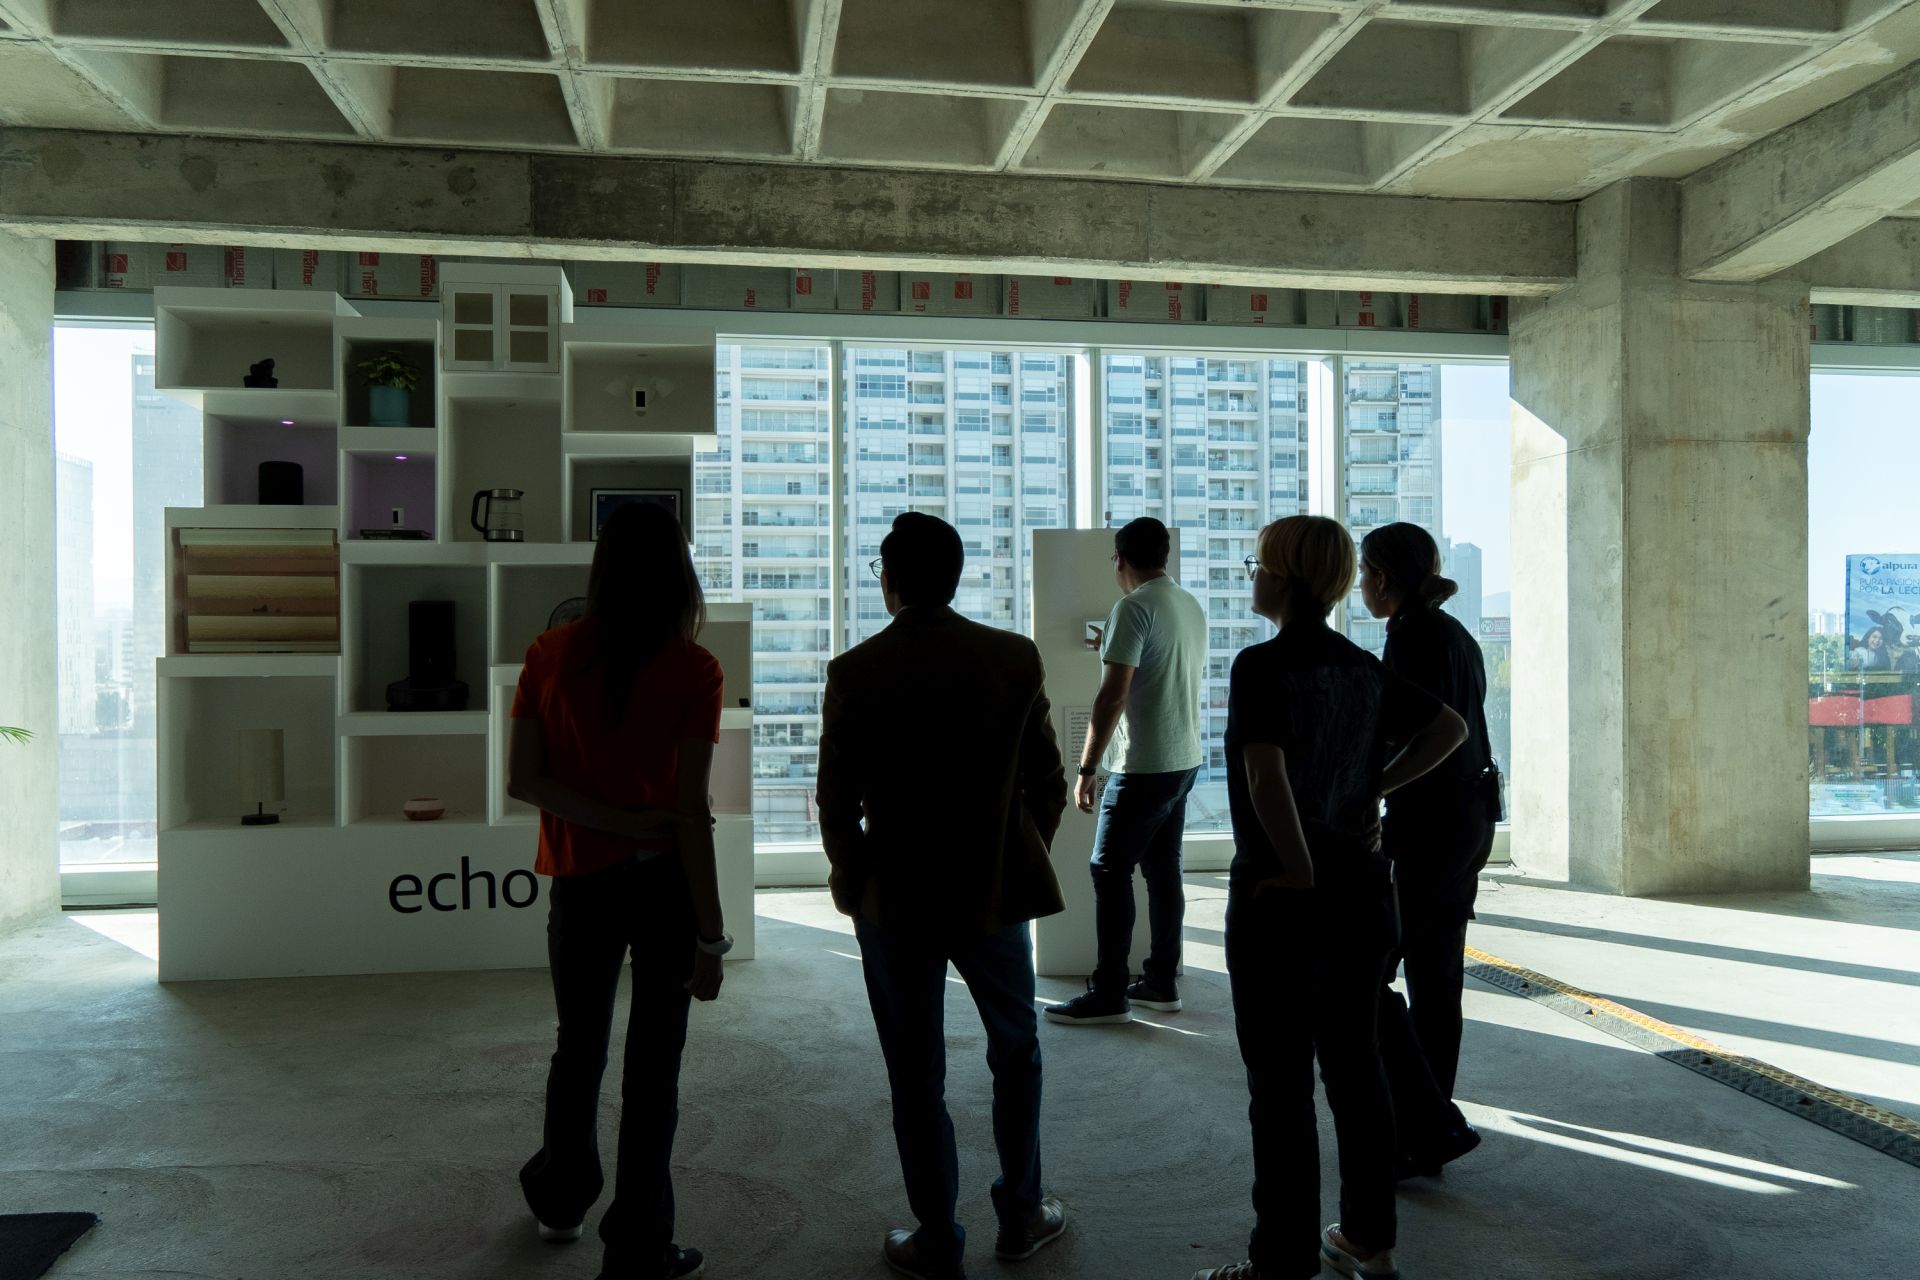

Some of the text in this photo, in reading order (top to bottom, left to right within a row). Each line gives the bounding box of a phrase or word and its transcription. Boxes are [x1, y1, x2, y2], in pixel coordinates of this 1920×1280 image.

[1882, 562, 1918, 571] alpura
[1881, 586, 1895, 594] LA
[389, 856, 539, 914] echo
